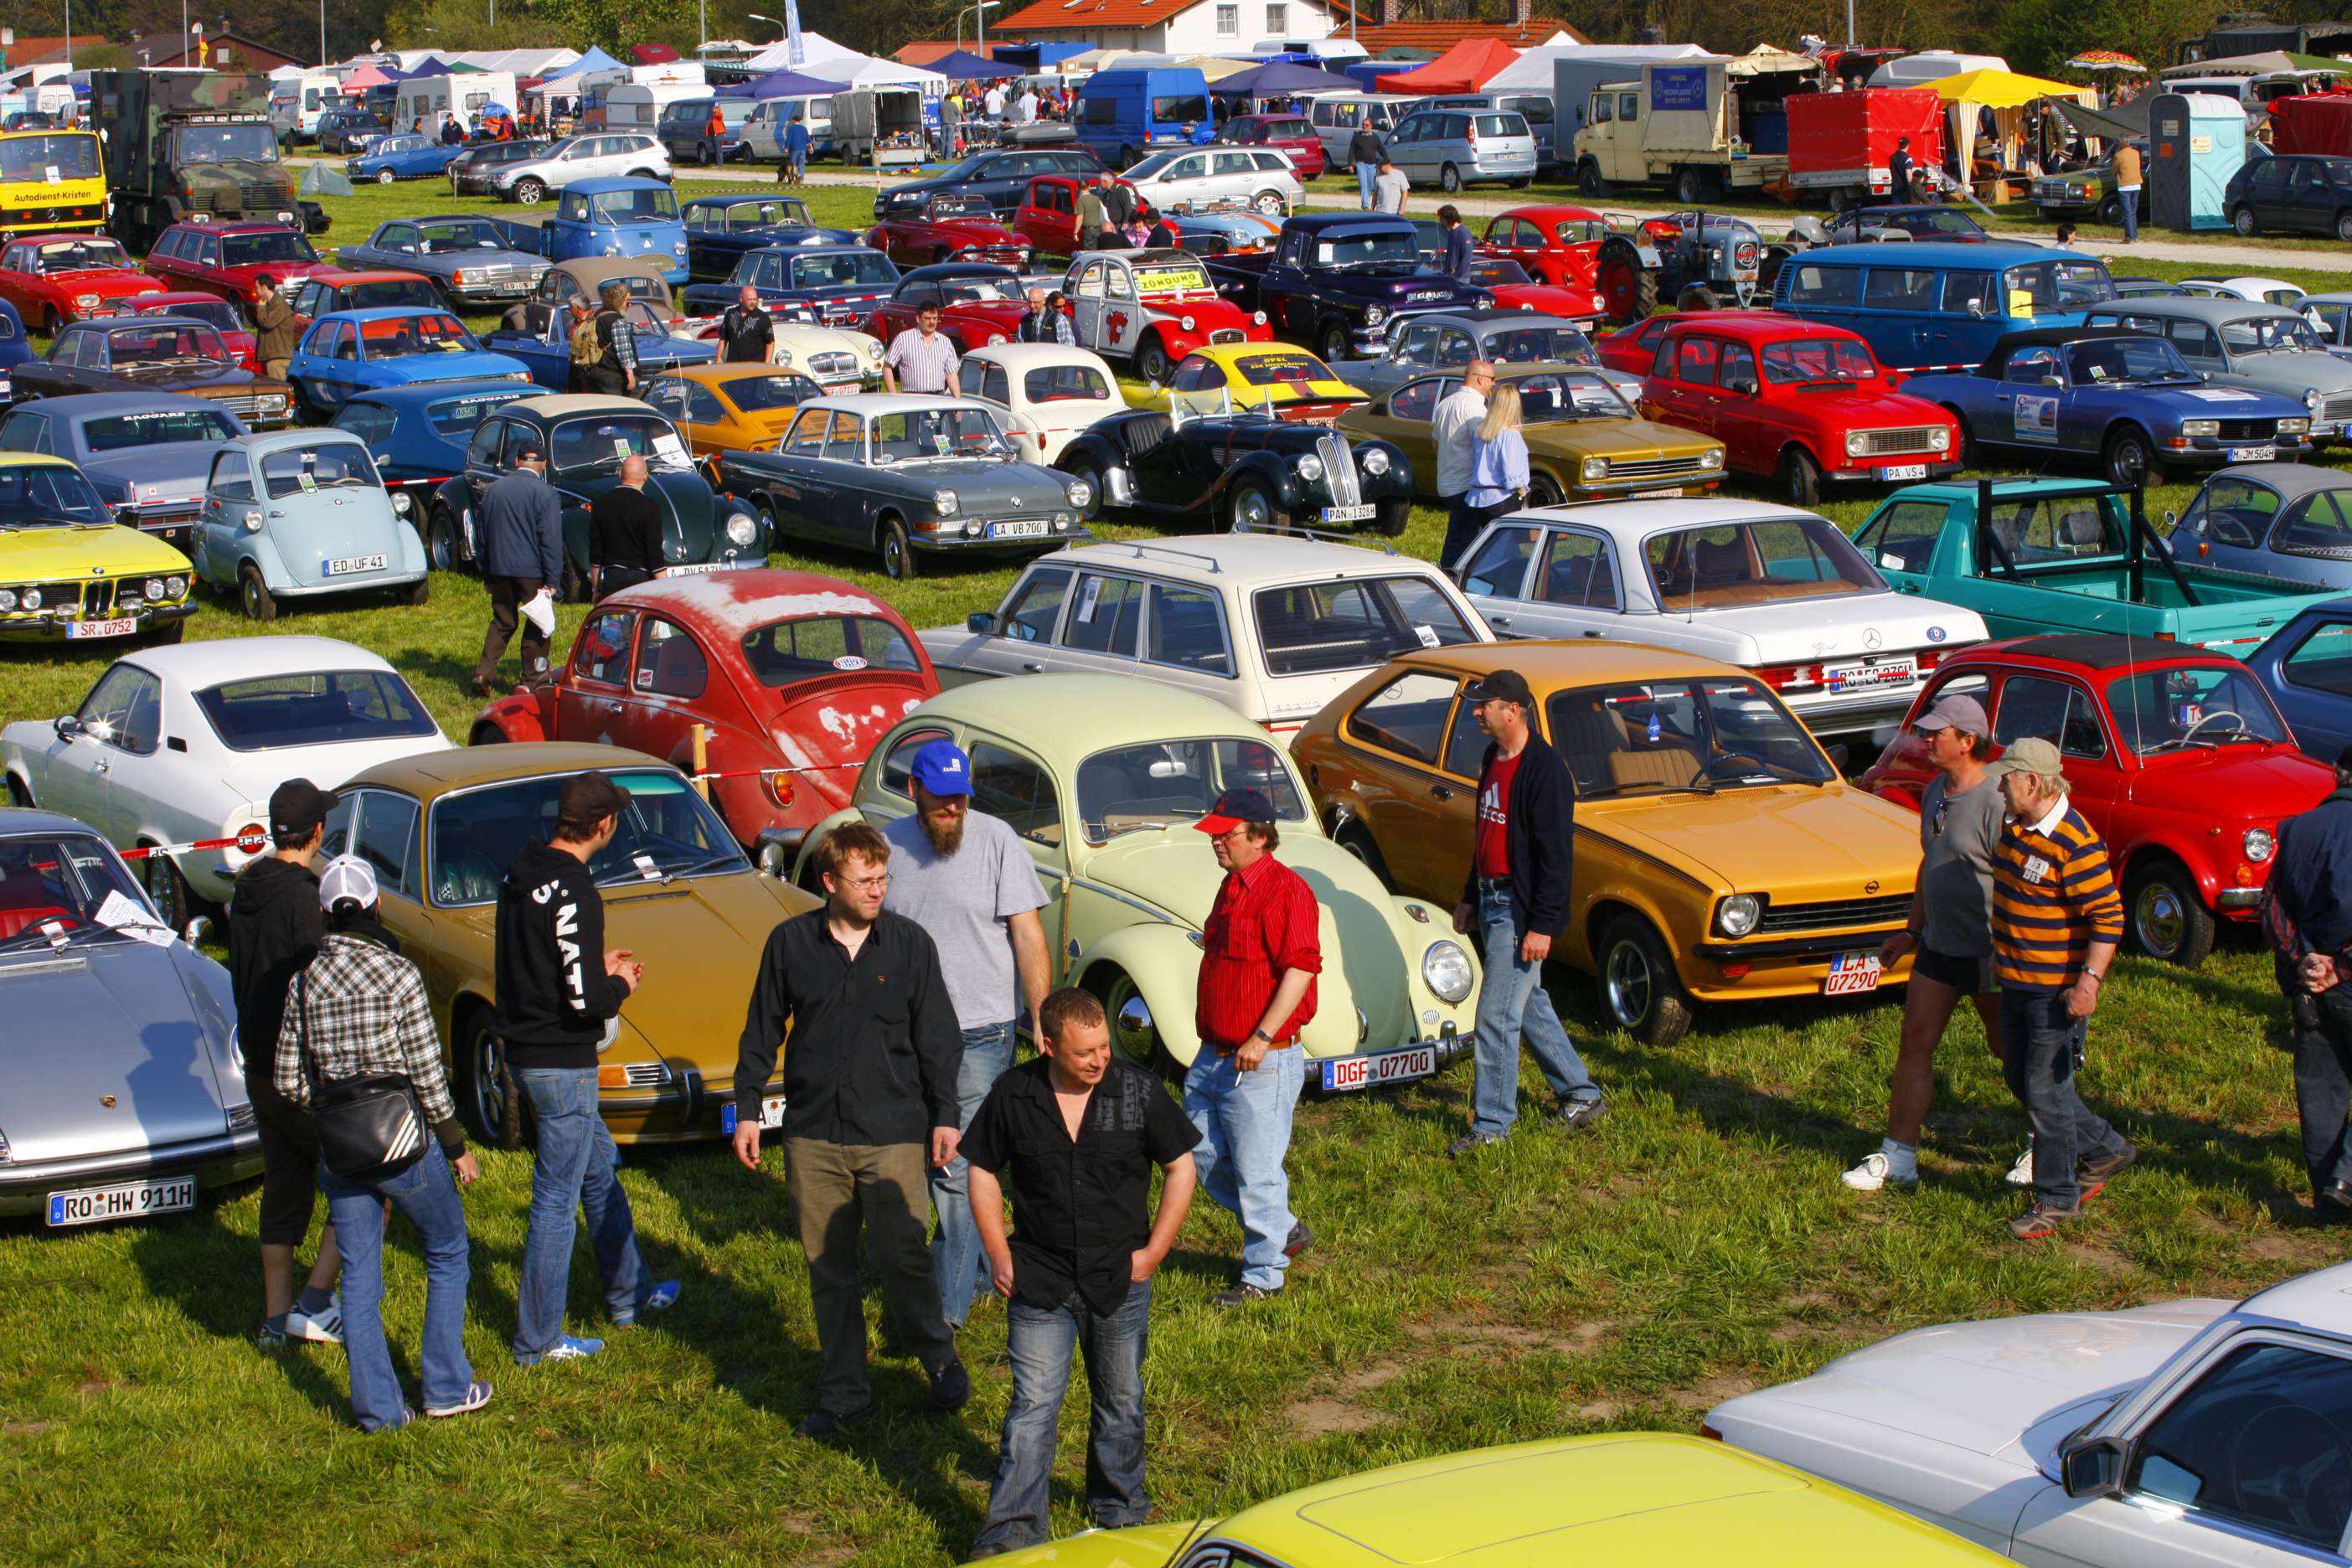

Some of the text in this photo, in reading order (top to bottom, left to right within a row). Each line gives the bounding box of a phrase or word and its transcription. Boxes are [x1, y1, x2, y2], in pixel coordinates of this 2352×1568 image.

[14, 190, 91, 202] Autodienst-Kristen
[123, 411, 185, 420] RAGGARE
[1889, 466, 1924, 479] PA VS 4
[1329, 508, 1348, 520] PAN
[994, 521, 1042, 535] LA VB 700
[333, 555, 384, 572] ED UF 41
[80, 620, 132, 637] SR 0752
[1843, 953, 1866, 972] LA
[1828, 970, 1878, 993] 07290
[1337, 1060, 1368, 1086] DGF
[1379, 1051, 1429, 1078] 07700
[65, 1195, 92, 1220] RO
[108, 1190, 135, 1214] HW
[140, 1183, 193, 1210] 911H
